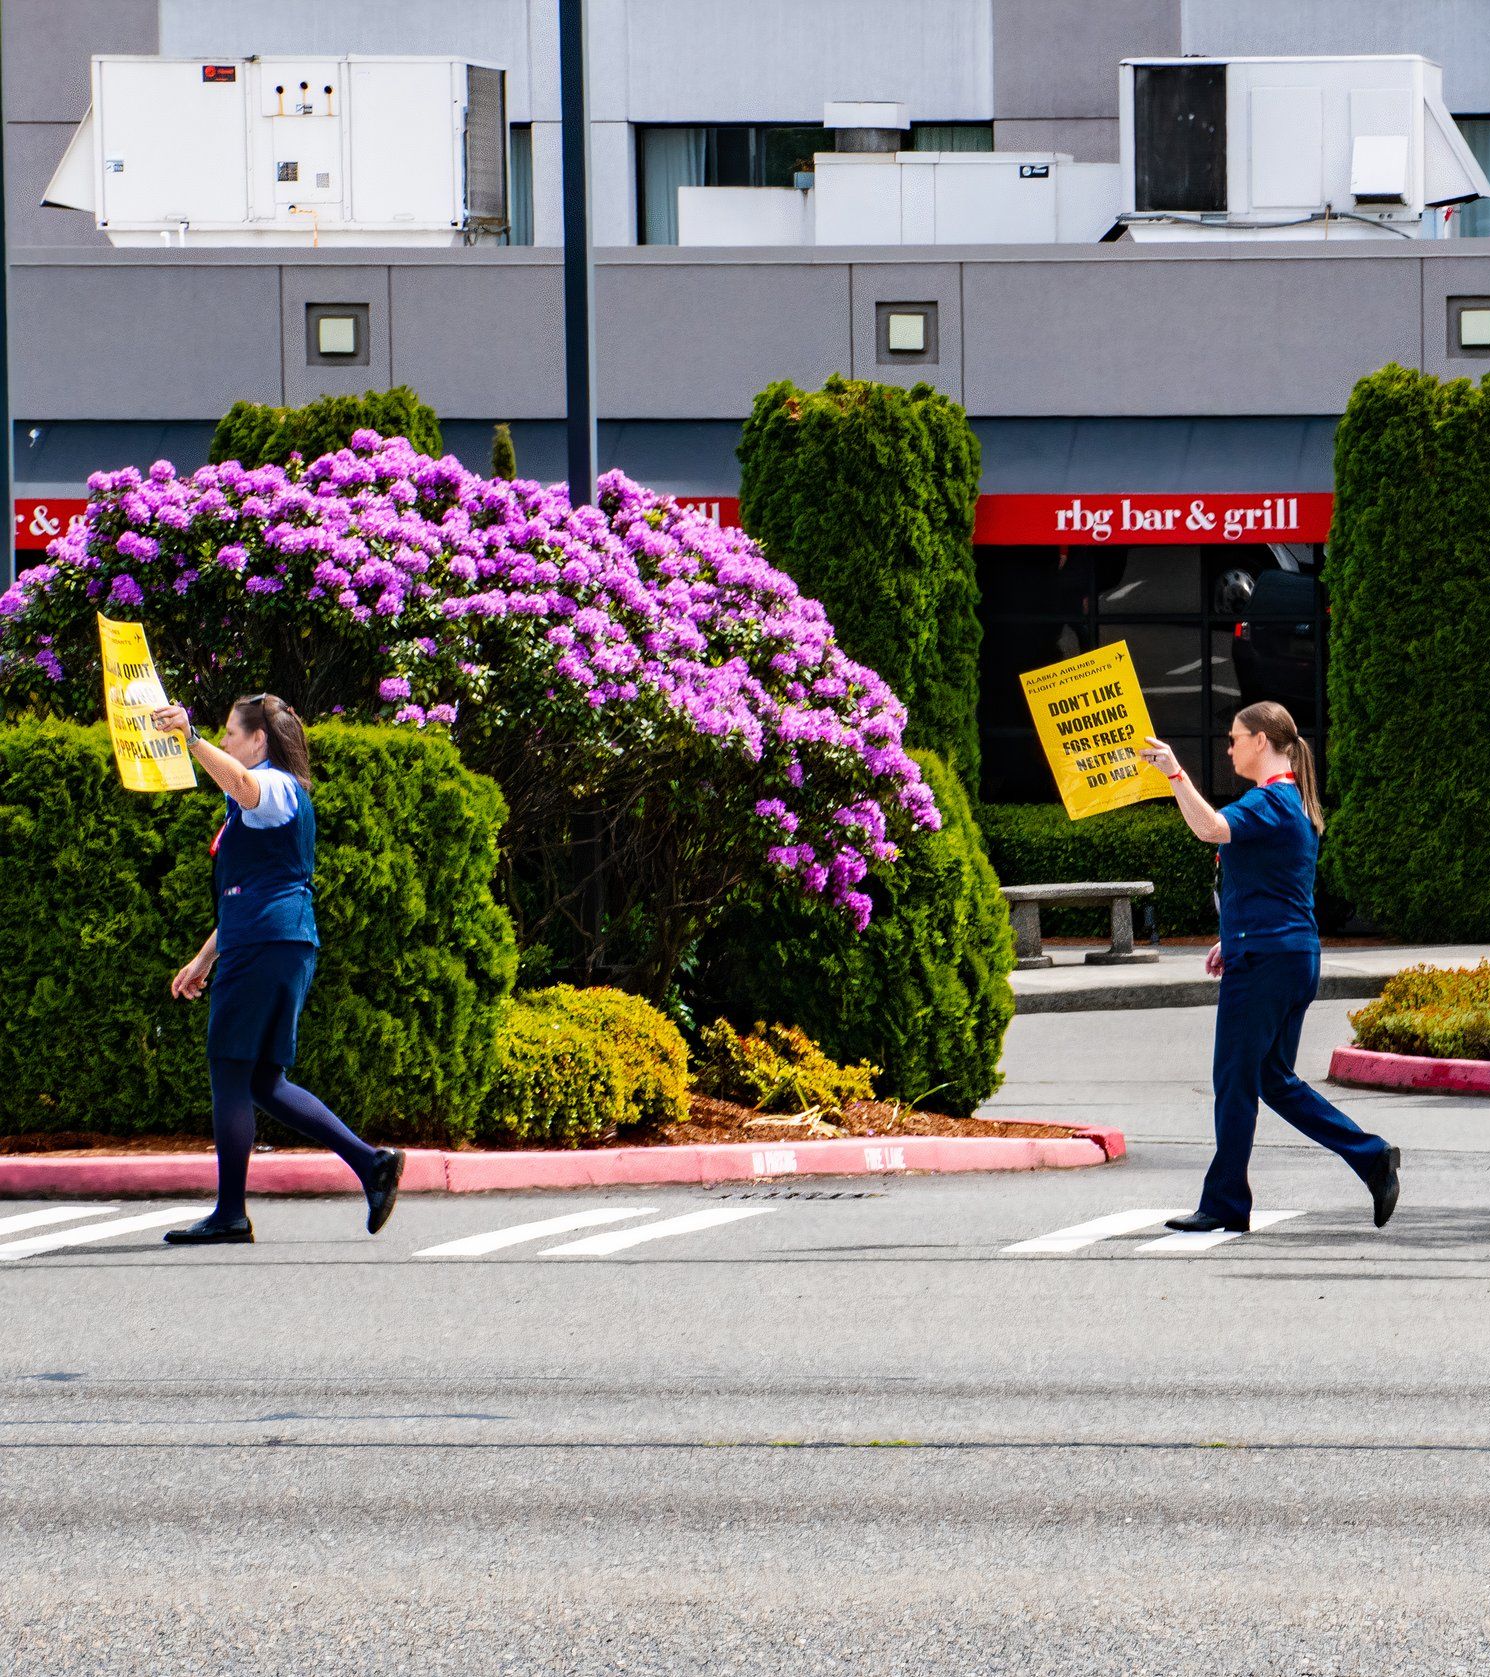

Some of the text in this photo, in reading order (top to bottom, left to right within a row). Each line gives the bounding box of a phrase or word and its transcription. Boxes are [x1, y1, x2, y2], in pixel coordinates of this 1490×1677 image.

[1055, 498, 1301, 542] rbg bar & grill
[123, 663, 151, 680] QUIT
[1026, 659, 1096, 687] ALASKA AIRLINES
[1028, 663, 1113, 695] FLIGHT ATTENDANTS
[1048, 681, 1124, 718] DON'T LIKE
[126, 715, 146, 731] PAY
[1056, 703, 1129, 737] WORKING
[115, 735, 182, 759] APPALLING
[1062, 724, 1135, 756] FOR FREE?
[1076, 746, 1137, 772] NEITHER
[1086, 764, 1139, 789] DO WE!
